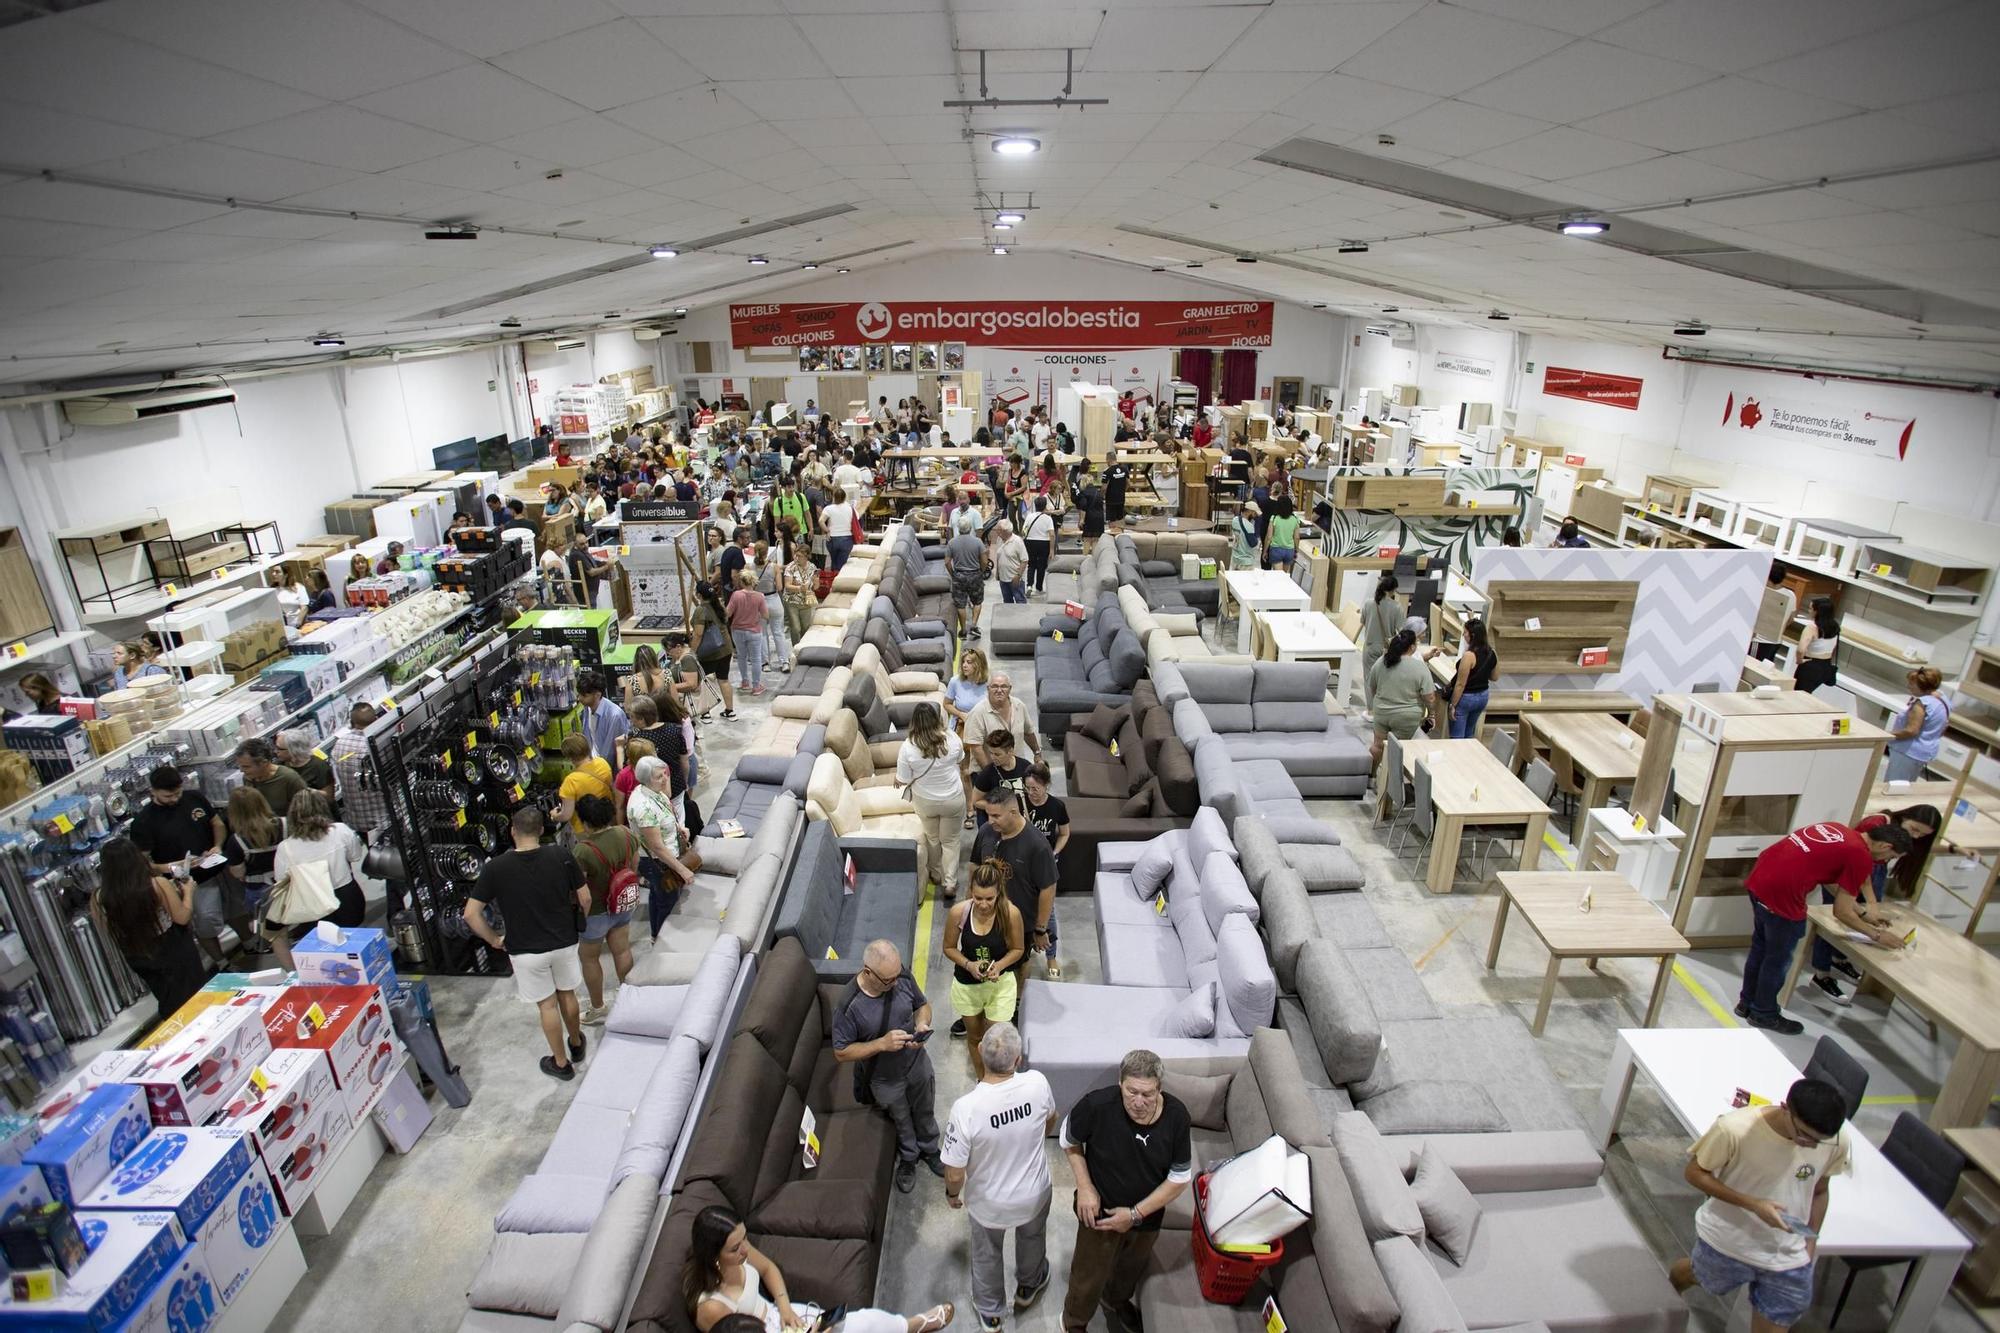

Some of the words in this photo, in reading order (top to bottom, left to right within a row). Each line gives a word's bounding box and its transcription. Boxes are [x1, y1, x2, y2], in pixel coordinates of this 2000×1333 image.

[732, 303, 781, 319] MUEBLES
[796, 310, 835, 323] SONIDO
[1183, 307, 1214, 319] GRAN
[1214, 303, 1259, 317] ELECTRO
[898, 307, 1140, 336] embargosalobestia
[1246, 319, 1259, 329] TV
[772, 330, 835, 346] COLCHONES
[1176, 324, 1213, 338] JARDÍN
[1231, 334, 1271, 347] HOGAR
[1044, 355, 1107, 365] COLCHONES
[1772, 408, 1781, 420] Te
[1781, 410, 1789, 421] lo
[1789, 412, 1829, 429] ponemos
[1829, 417, 1851, 432] fácil:
[1769, 420, 1795, 431] Financia
[1795, 425, 1805, 433] tus
[1804, 428, 1832, 439] compras
[1832, 431, 1842, 439] en
[1842, 432, 1853, 442] 36
[1853, 435, 1877, 447] meses
[990, 1102, 1032, 1129] QUINO
